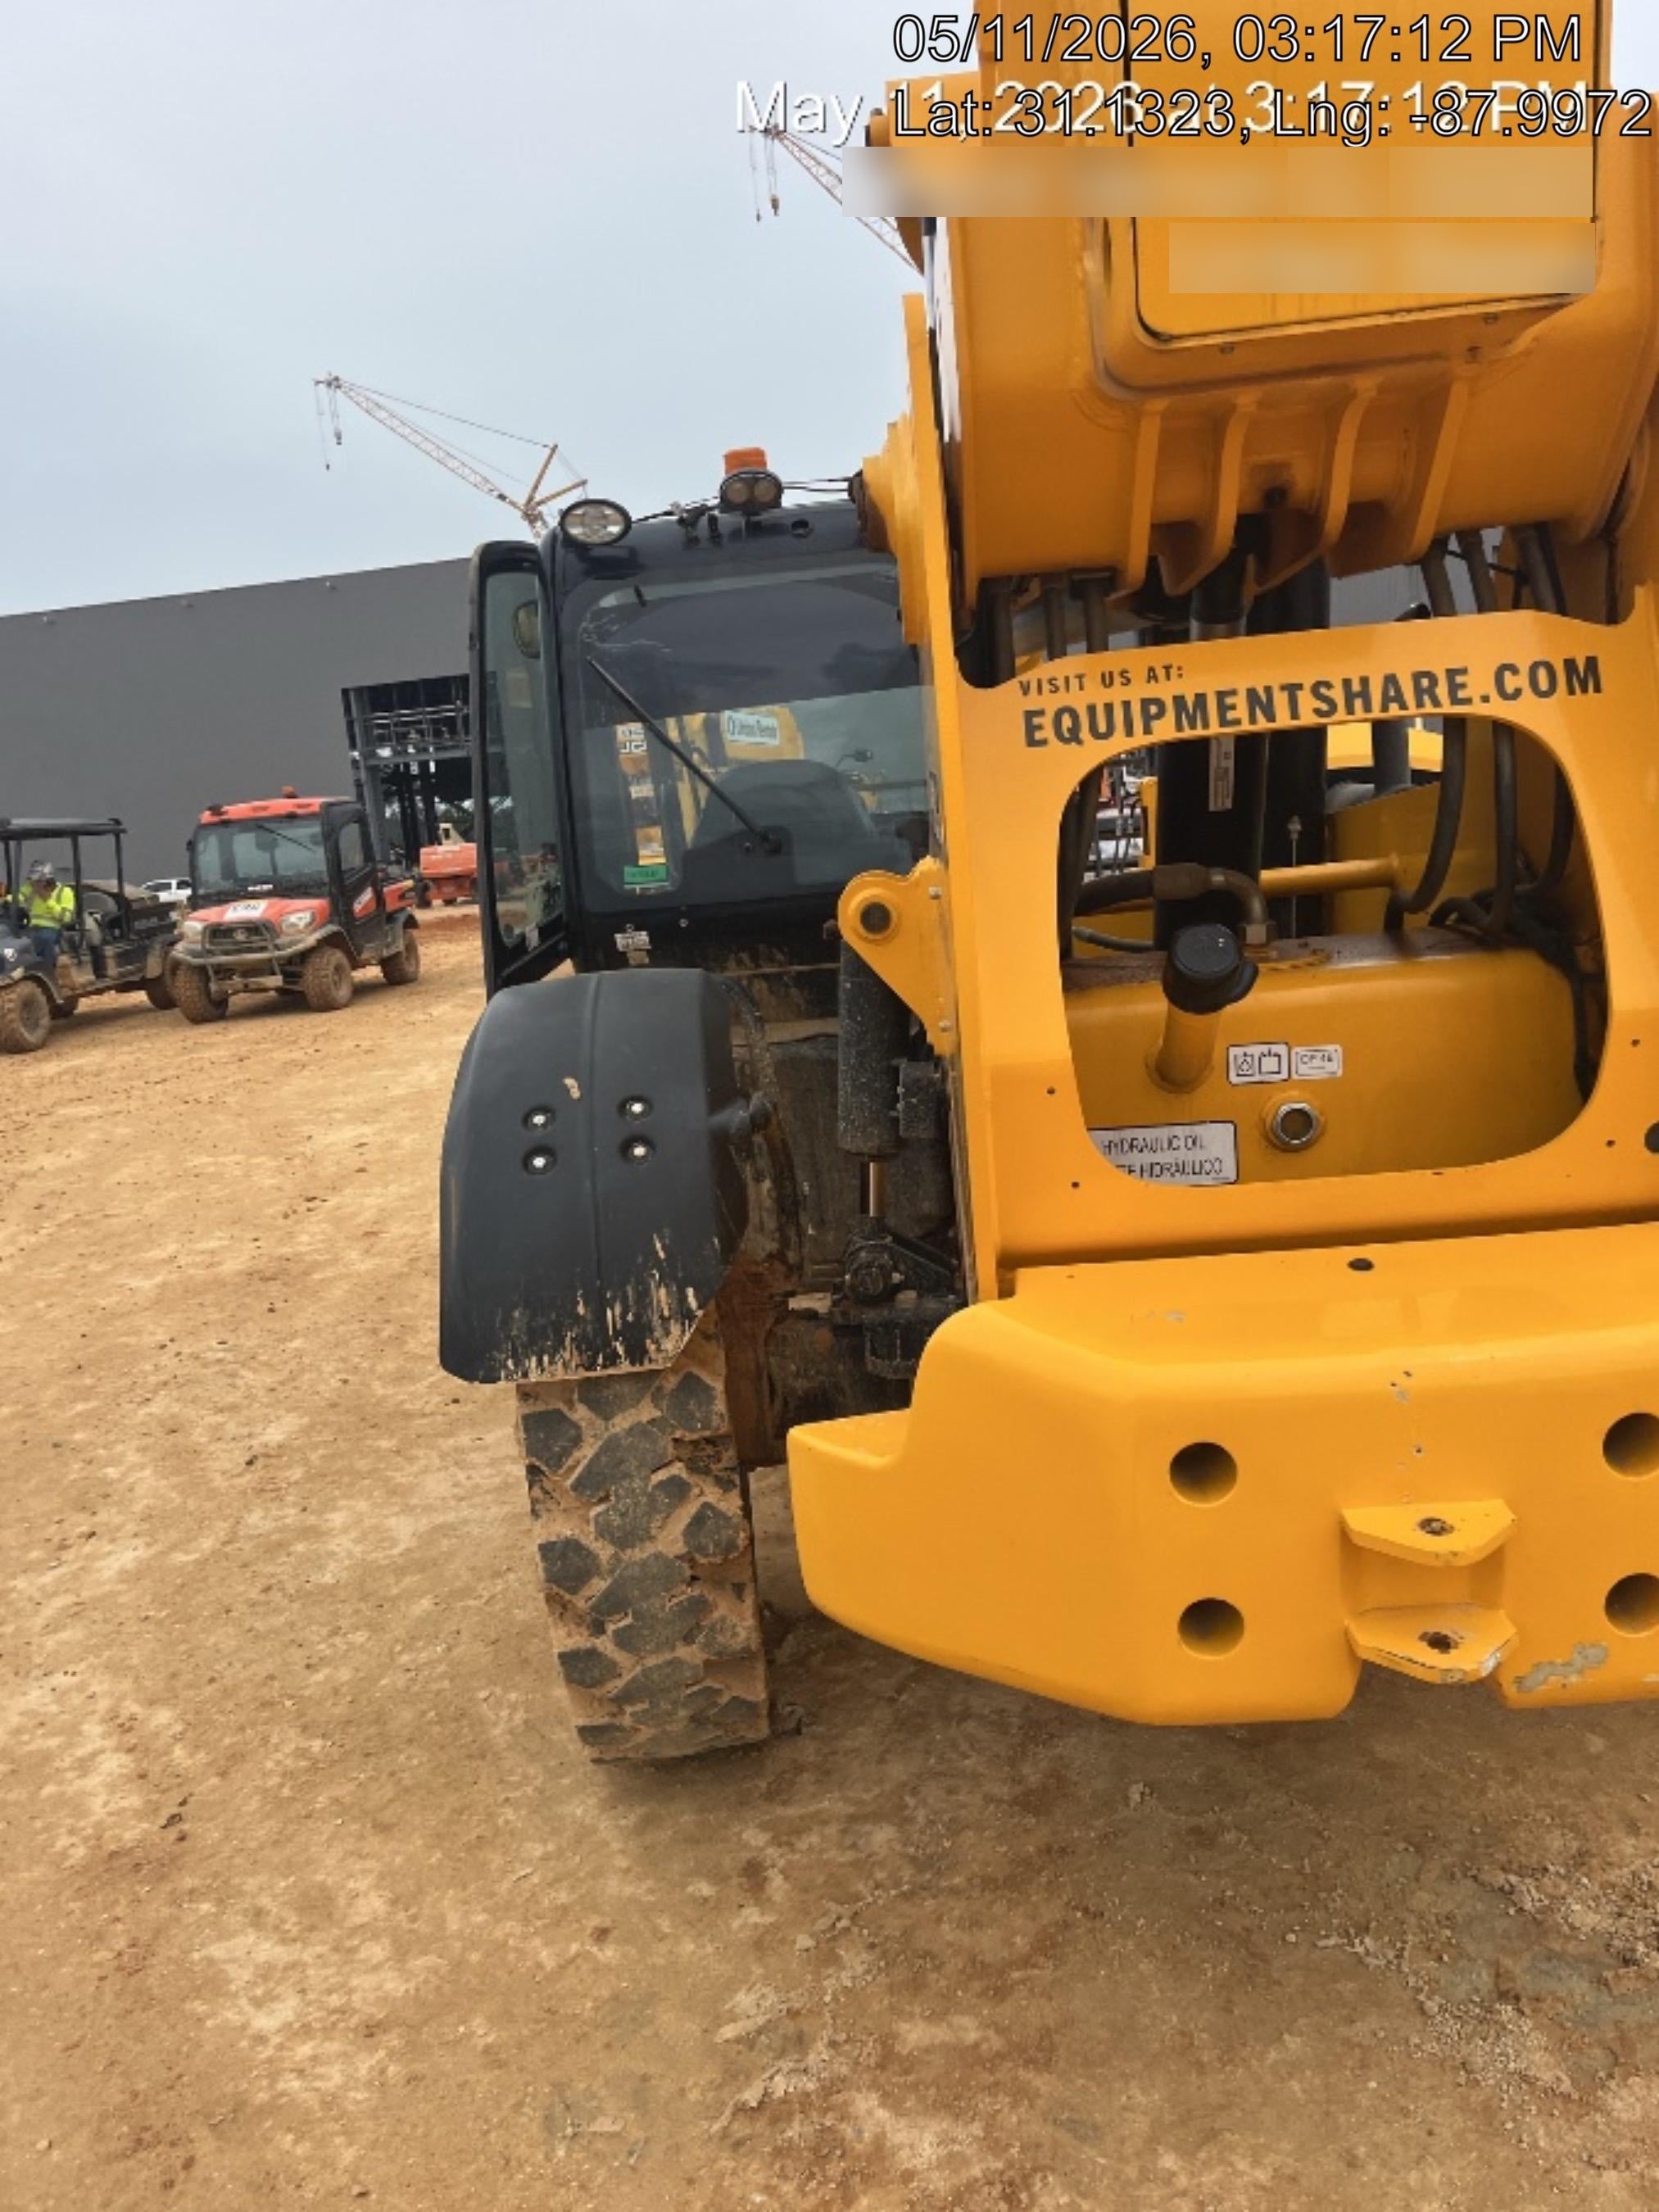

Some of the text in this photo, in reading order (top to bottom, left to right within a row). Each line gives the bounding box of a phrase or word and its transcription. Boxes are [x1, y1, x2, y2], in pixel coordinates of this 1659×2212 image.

[1018, 664, 1183, 696] VISIT US AT:
[1023, 655, 1602, 748] EQUIPMENTSHARE.COM
